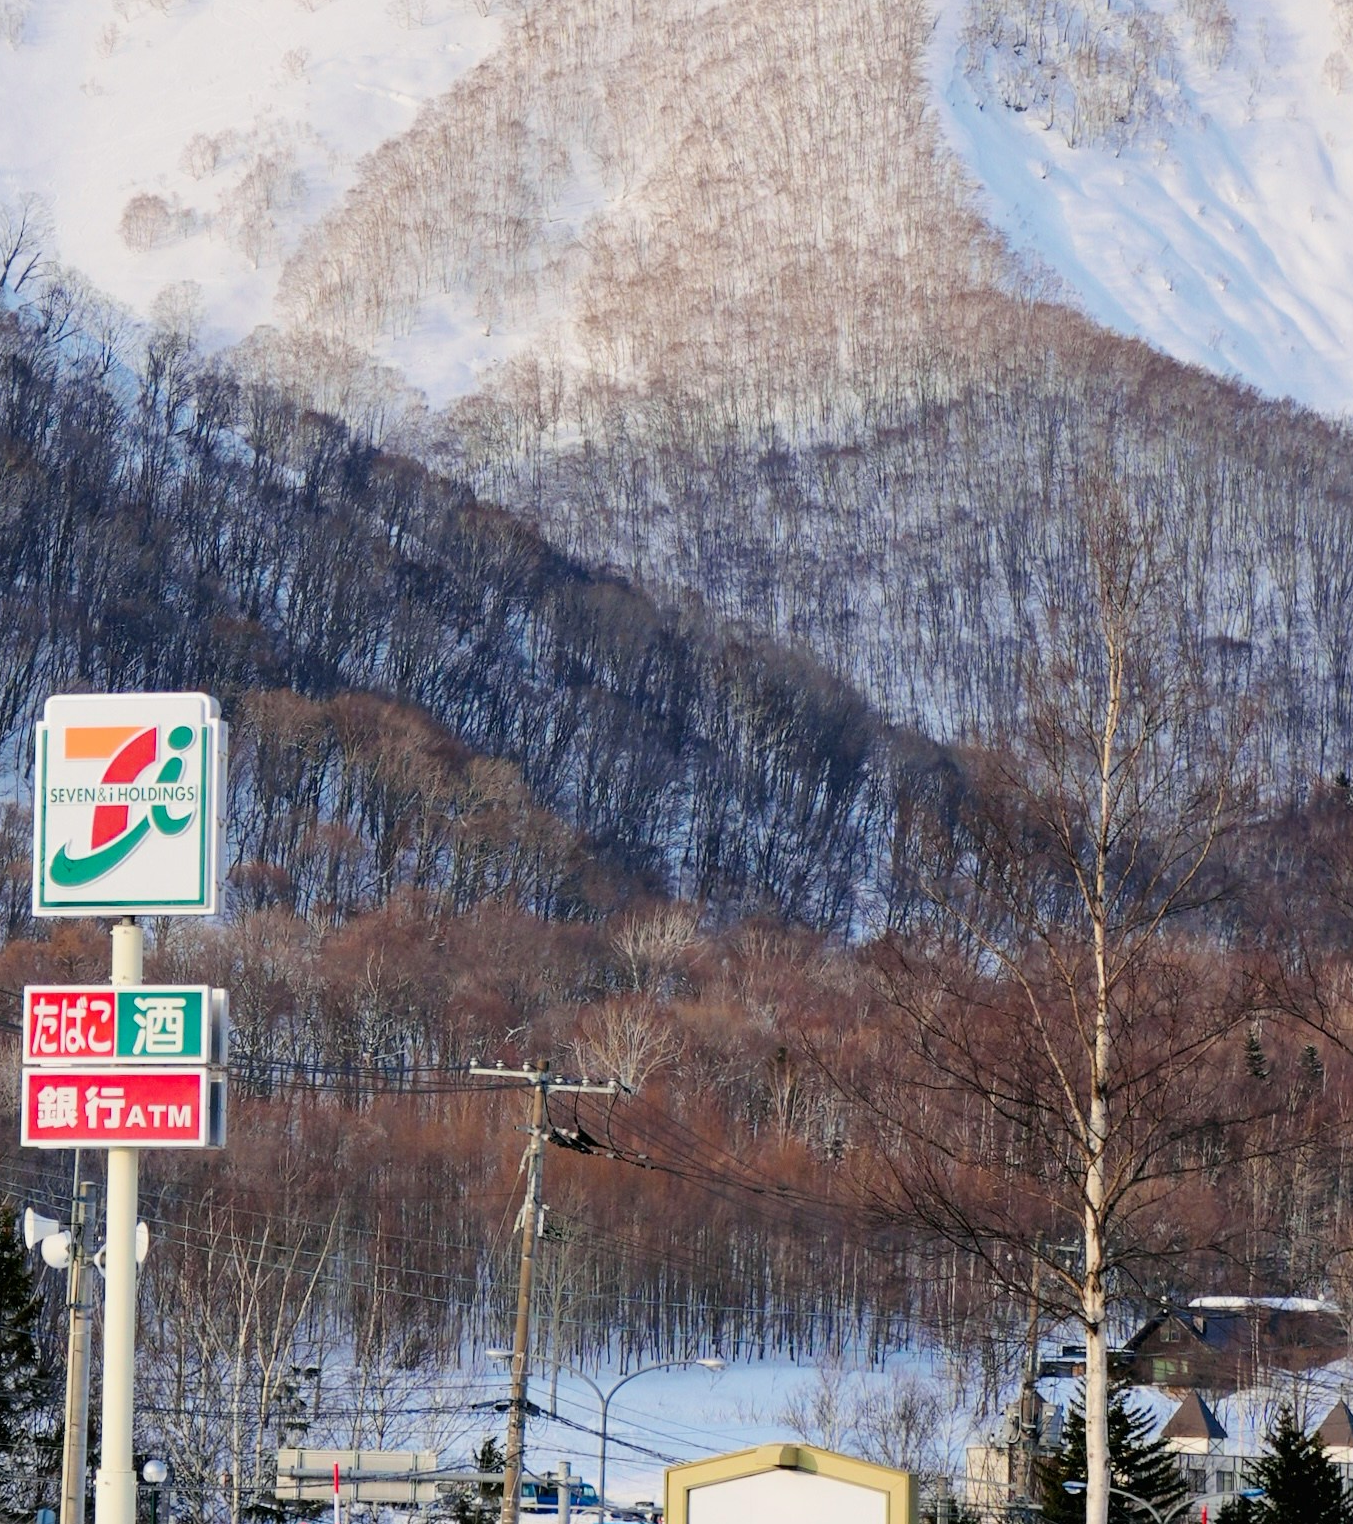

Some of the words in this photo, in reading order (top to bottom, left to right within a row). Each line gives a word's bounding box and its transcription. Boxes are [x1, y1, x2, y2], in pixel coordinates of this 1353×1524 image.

[118, 785, 195, 802] HOLDINGS
[31, 996, 112, 1055] たばこ
[132, 996, 187, 1055] 酒
